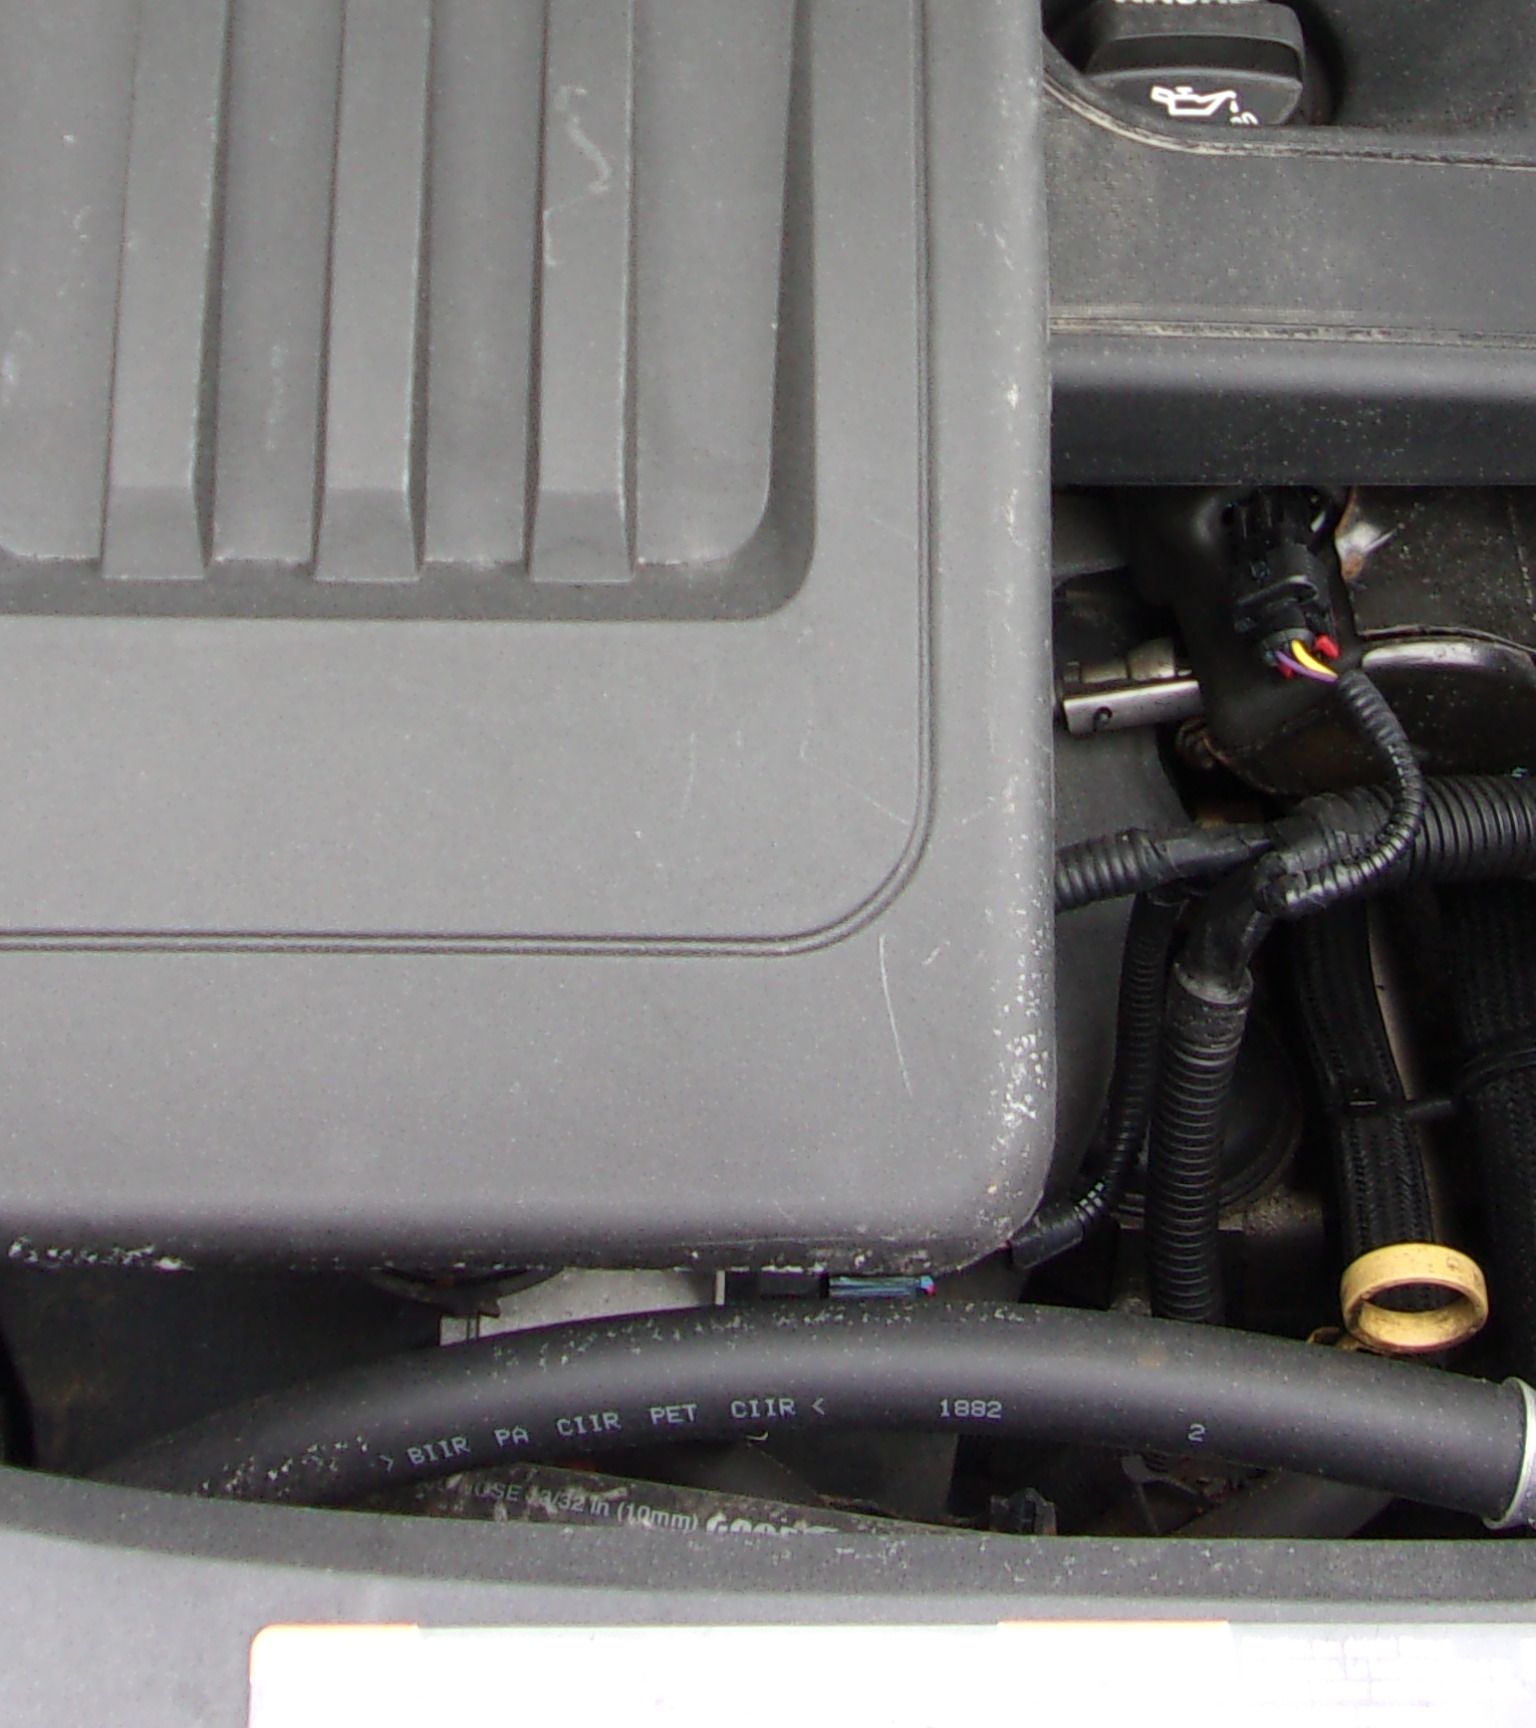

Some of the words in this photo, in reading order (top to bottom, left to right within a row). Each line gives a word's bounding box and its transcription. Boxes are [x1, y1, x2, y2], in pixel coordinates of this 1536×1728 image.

[407, 1436, 471, 1466] BIIR
[494, 1425, 530, 1448] PA
[556, 1411, 622, 1437] CIIR
[649, 1403, 697, 1426] PET
[730, 1397, 797, 1420] CIIR
[939, 1398, 1003, 1420] 1882
[1187, 1423, 1206, 1443] 2
